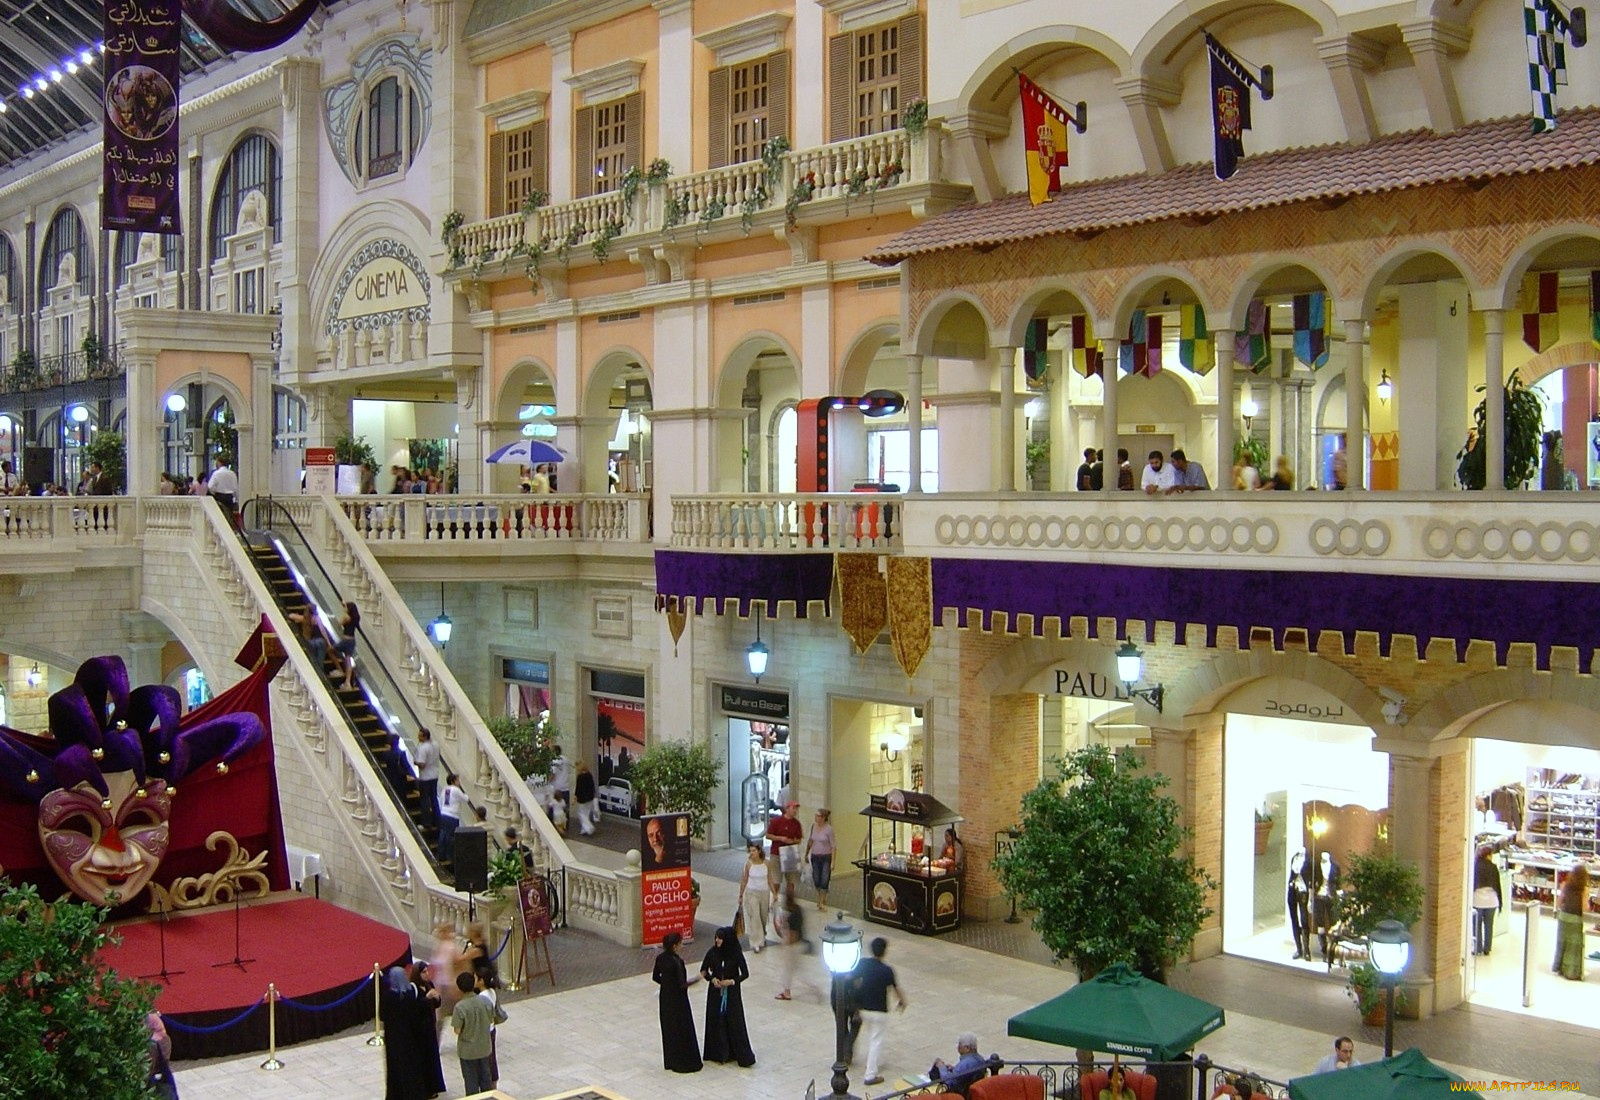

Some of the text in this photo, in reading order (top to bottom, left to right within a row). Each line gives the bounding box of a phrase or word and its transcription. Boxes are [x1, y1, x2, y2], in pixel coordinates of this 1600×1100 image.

[106, 30, 178, 56] سادتي
[166, 173, 175, 190] في
[355, 268, 408, 301] CINEMA
[724, 692, 741, 705] Pull
[759, 699, 787, 711] Bear
[1265, 699, 1343, 720] برومود
[652, 880, 681, 891] PAULO
[644, 890, 690, 905] COELHO
[1106, 1042, 1153, 1055] STARBUCKS COFFEE
